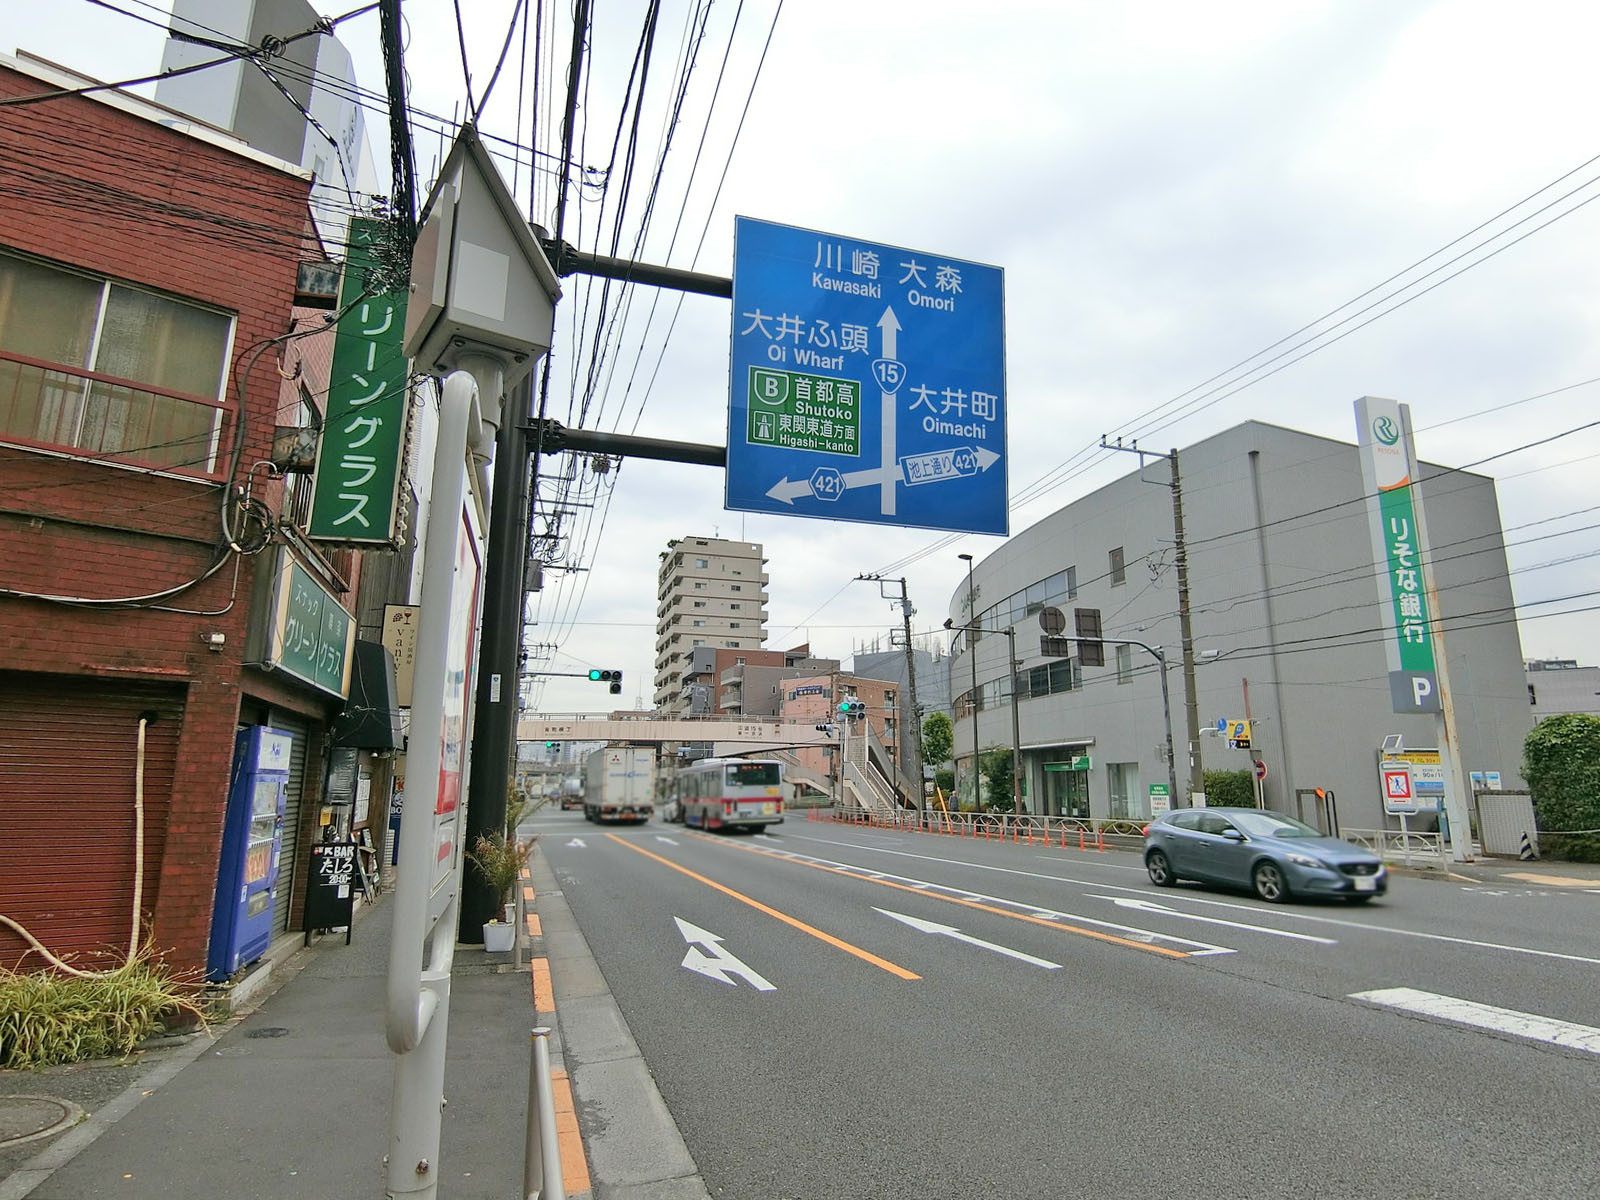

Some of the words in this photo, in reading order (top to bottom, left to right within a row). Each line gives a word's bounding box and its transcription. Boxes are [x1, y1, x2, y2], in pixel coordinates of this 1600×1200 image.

[814, 241, 880, 280] 川崎
[812, 272, 881, 299] Kawasaki
[899, 260, 963, 295] 大森
[908, 290, 954, 312] Omori
[741, 308, 869, 356] 大井ふ頭
[768, 344, 786, 362] Oi
[793, 348, 844, 371] Wharf
[878, 363, 898, 384] 15
[765, 376, 779, 397] B
[795, 377, 854, 406] 首都高
[333, 272, 393, 527] リーングラス
[795, 401, 852, 420] Shutoko
[909, 383, 997, 423] 大井町
[779, 414, 855, 441] 東関東道方面
[922, 417, 986, 440] Oimachi
[780, 434, 854, 452] Higashi-kanto
[909, 456, 952, 479] 池上通り
[955, 454, 976, 470] 421
[815, 474, 841, 494] 421
[1391, 517, 1424, 643] りそな銀行
[1412, 677, 1431, 706] P
[334, 846, 355, 857] BAR
[320, 857, 353, 873] たしろ
